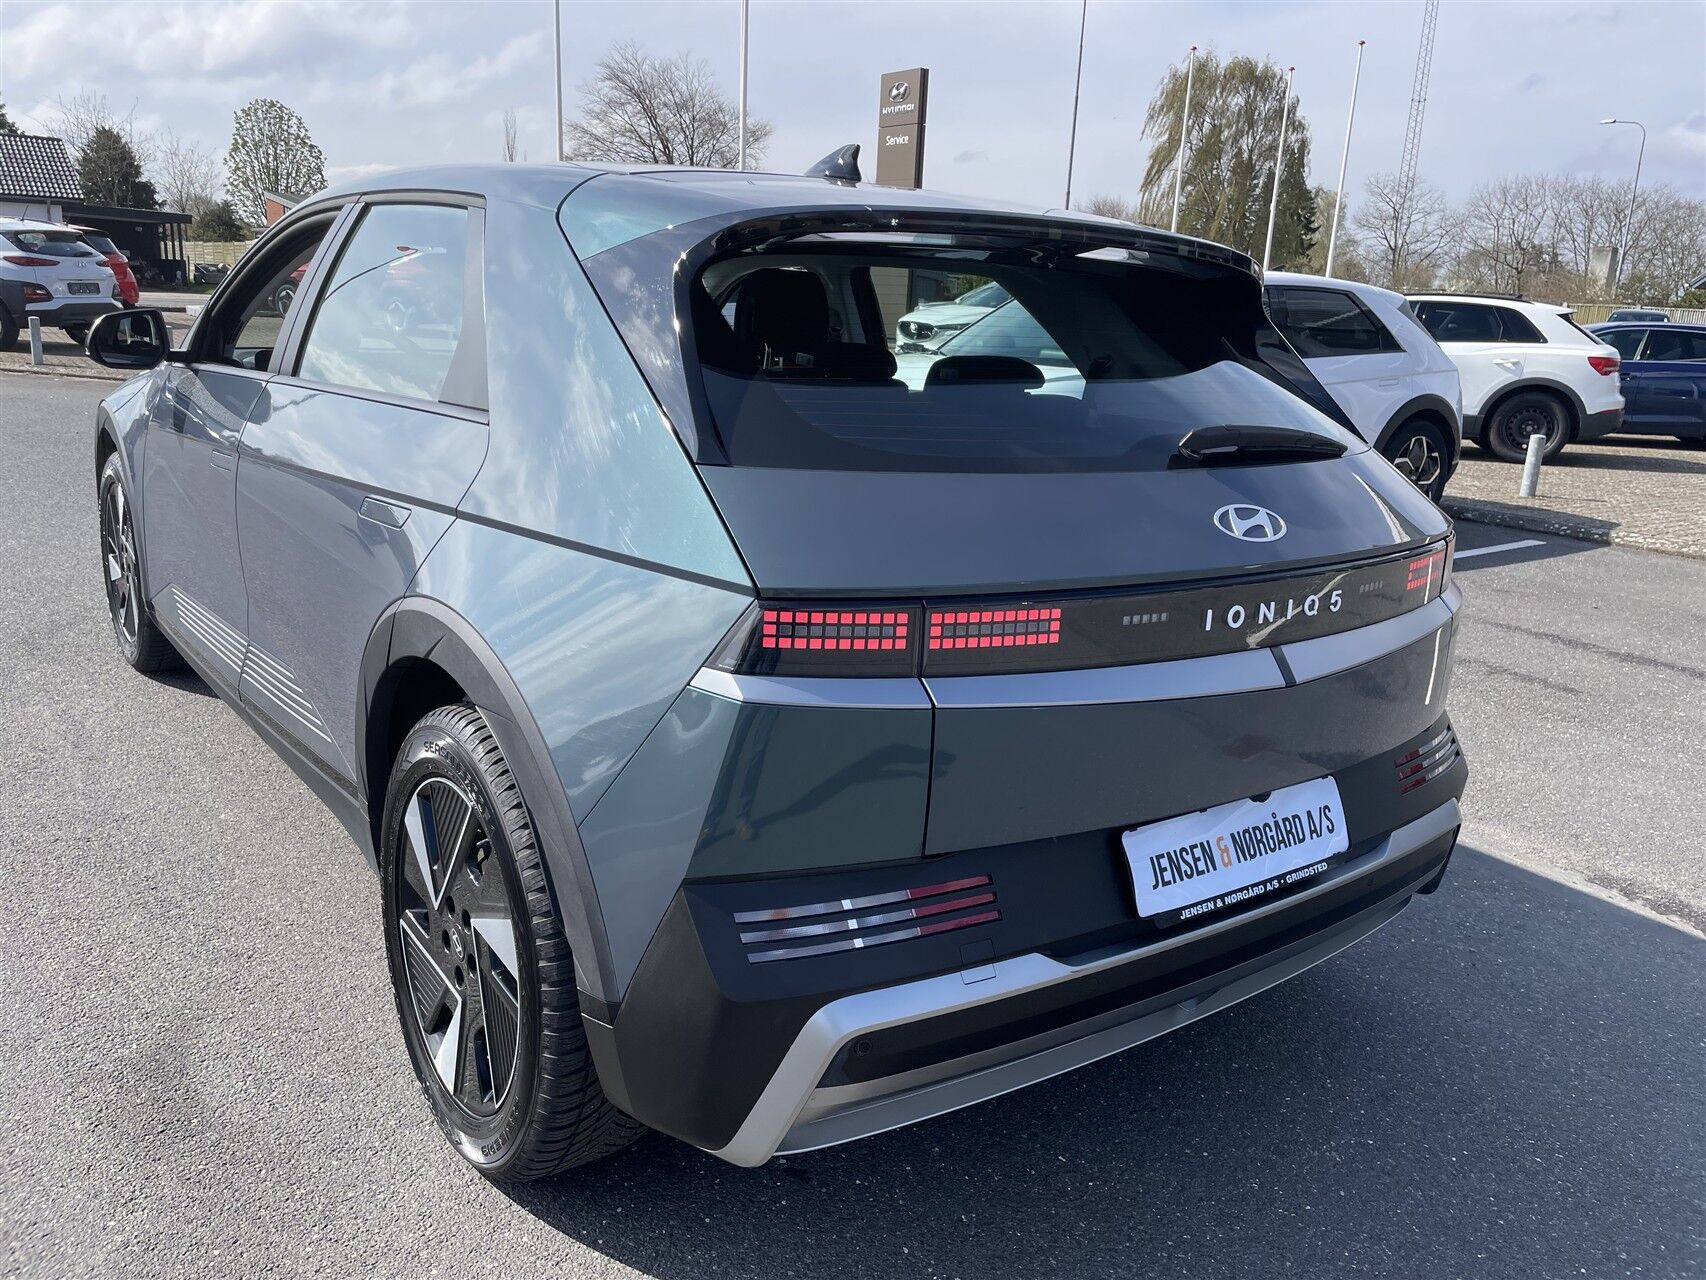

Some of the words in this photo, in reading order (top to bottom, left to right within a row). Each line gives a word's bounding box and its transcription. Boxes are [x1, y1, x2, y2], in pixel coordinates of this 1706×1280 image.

[885, 134, 909, 146] Service
[1149, 840, 1218, 890] JENSEN
[1215, 835, 1233, 868] &
[1230, 812, 1305, 864] NØRGÅRD
[1306, 805, 1336, 840] A/S
[1180, 900, 1215, 920] JENSEN
[1216, 899, 1224, 908] &
[1224, 885, 1265, 904] NØRGÅRD
[1266, 879, 1280, 893] A/S
[1285, 862, 1329, 884] GRINDSTED
